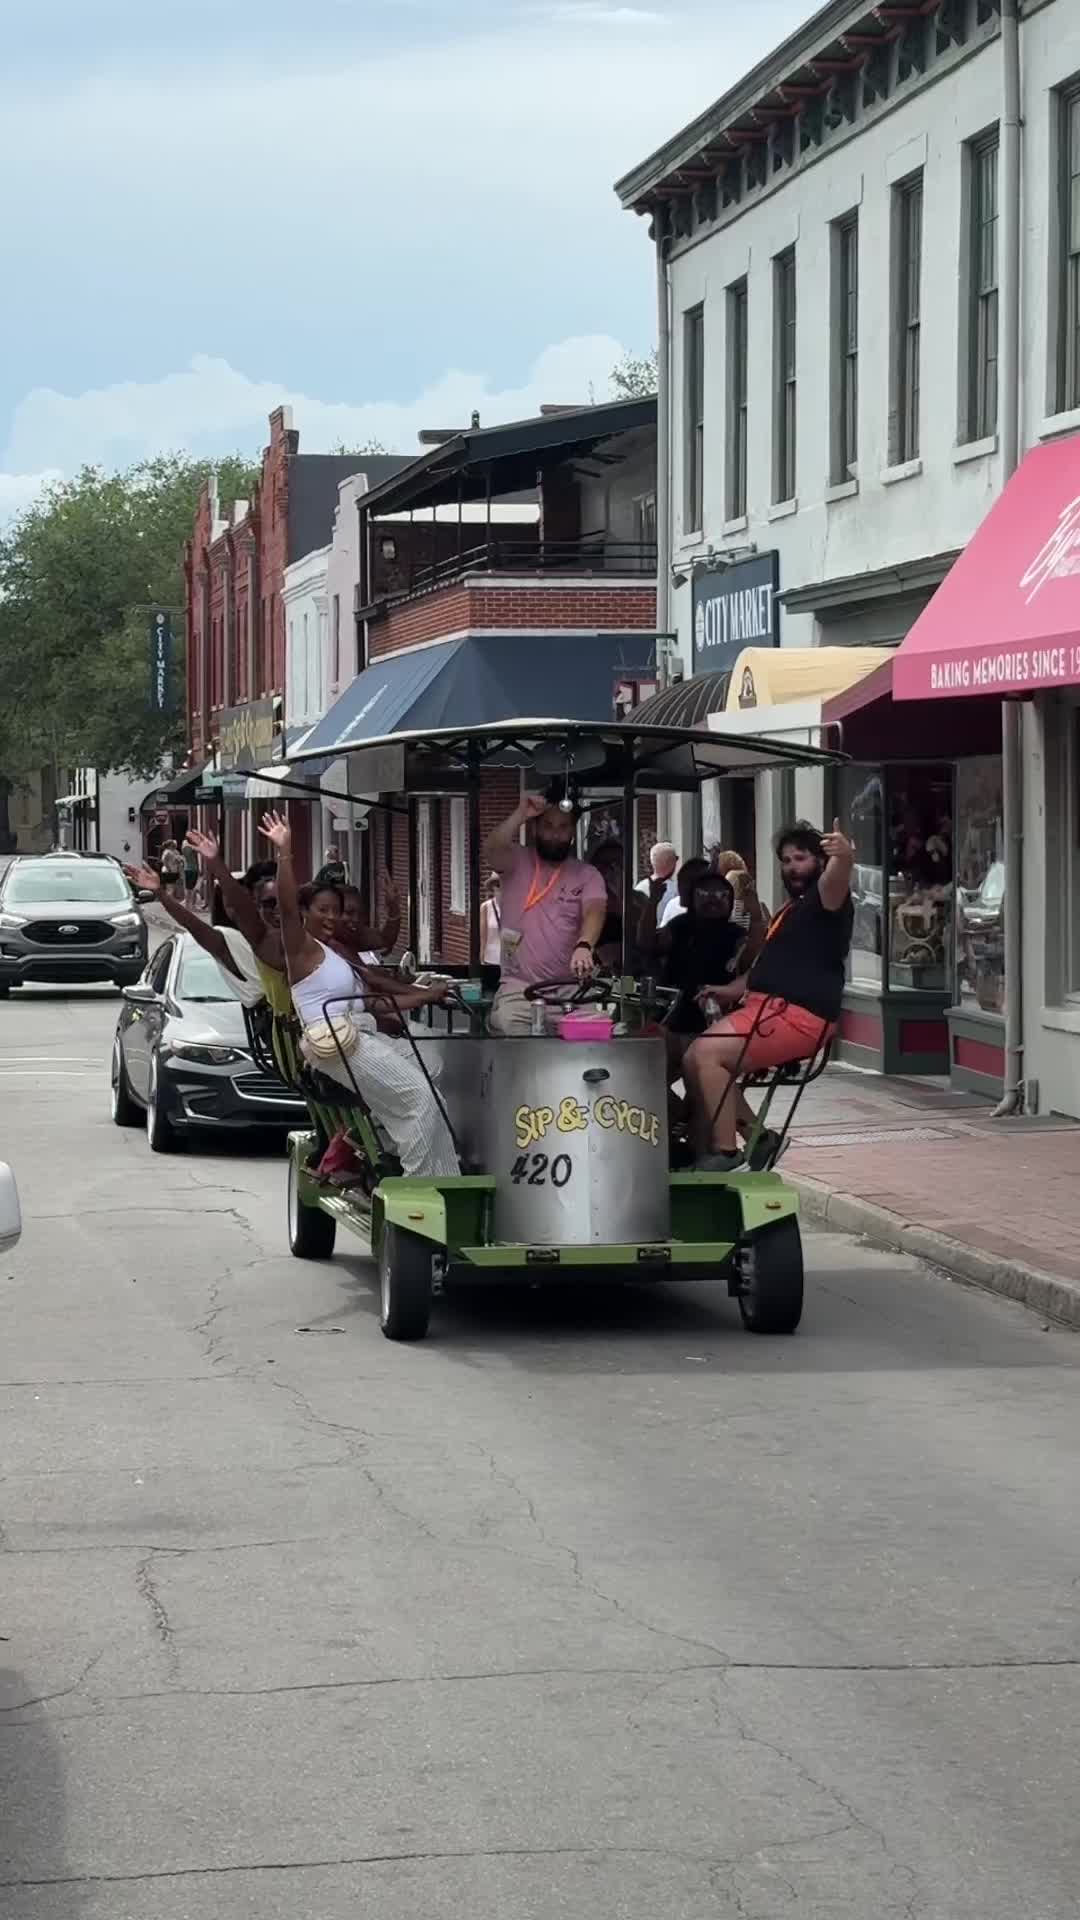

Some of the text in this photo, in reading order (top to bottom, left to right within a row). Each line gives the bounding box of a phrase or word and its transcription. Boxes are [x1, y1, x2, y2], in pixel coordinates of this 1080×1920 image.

[705, 583, 773, 647] CITY MARKET
[930, 661, 970, 689] BAKING
[973, 652, 1029, 685] MEMORIES
[1031, 647, 1066, 679] SINCE
[515, 1095, 661, 1149] SIP & CYCLE
[510, 1153, 572, 1188] 420
